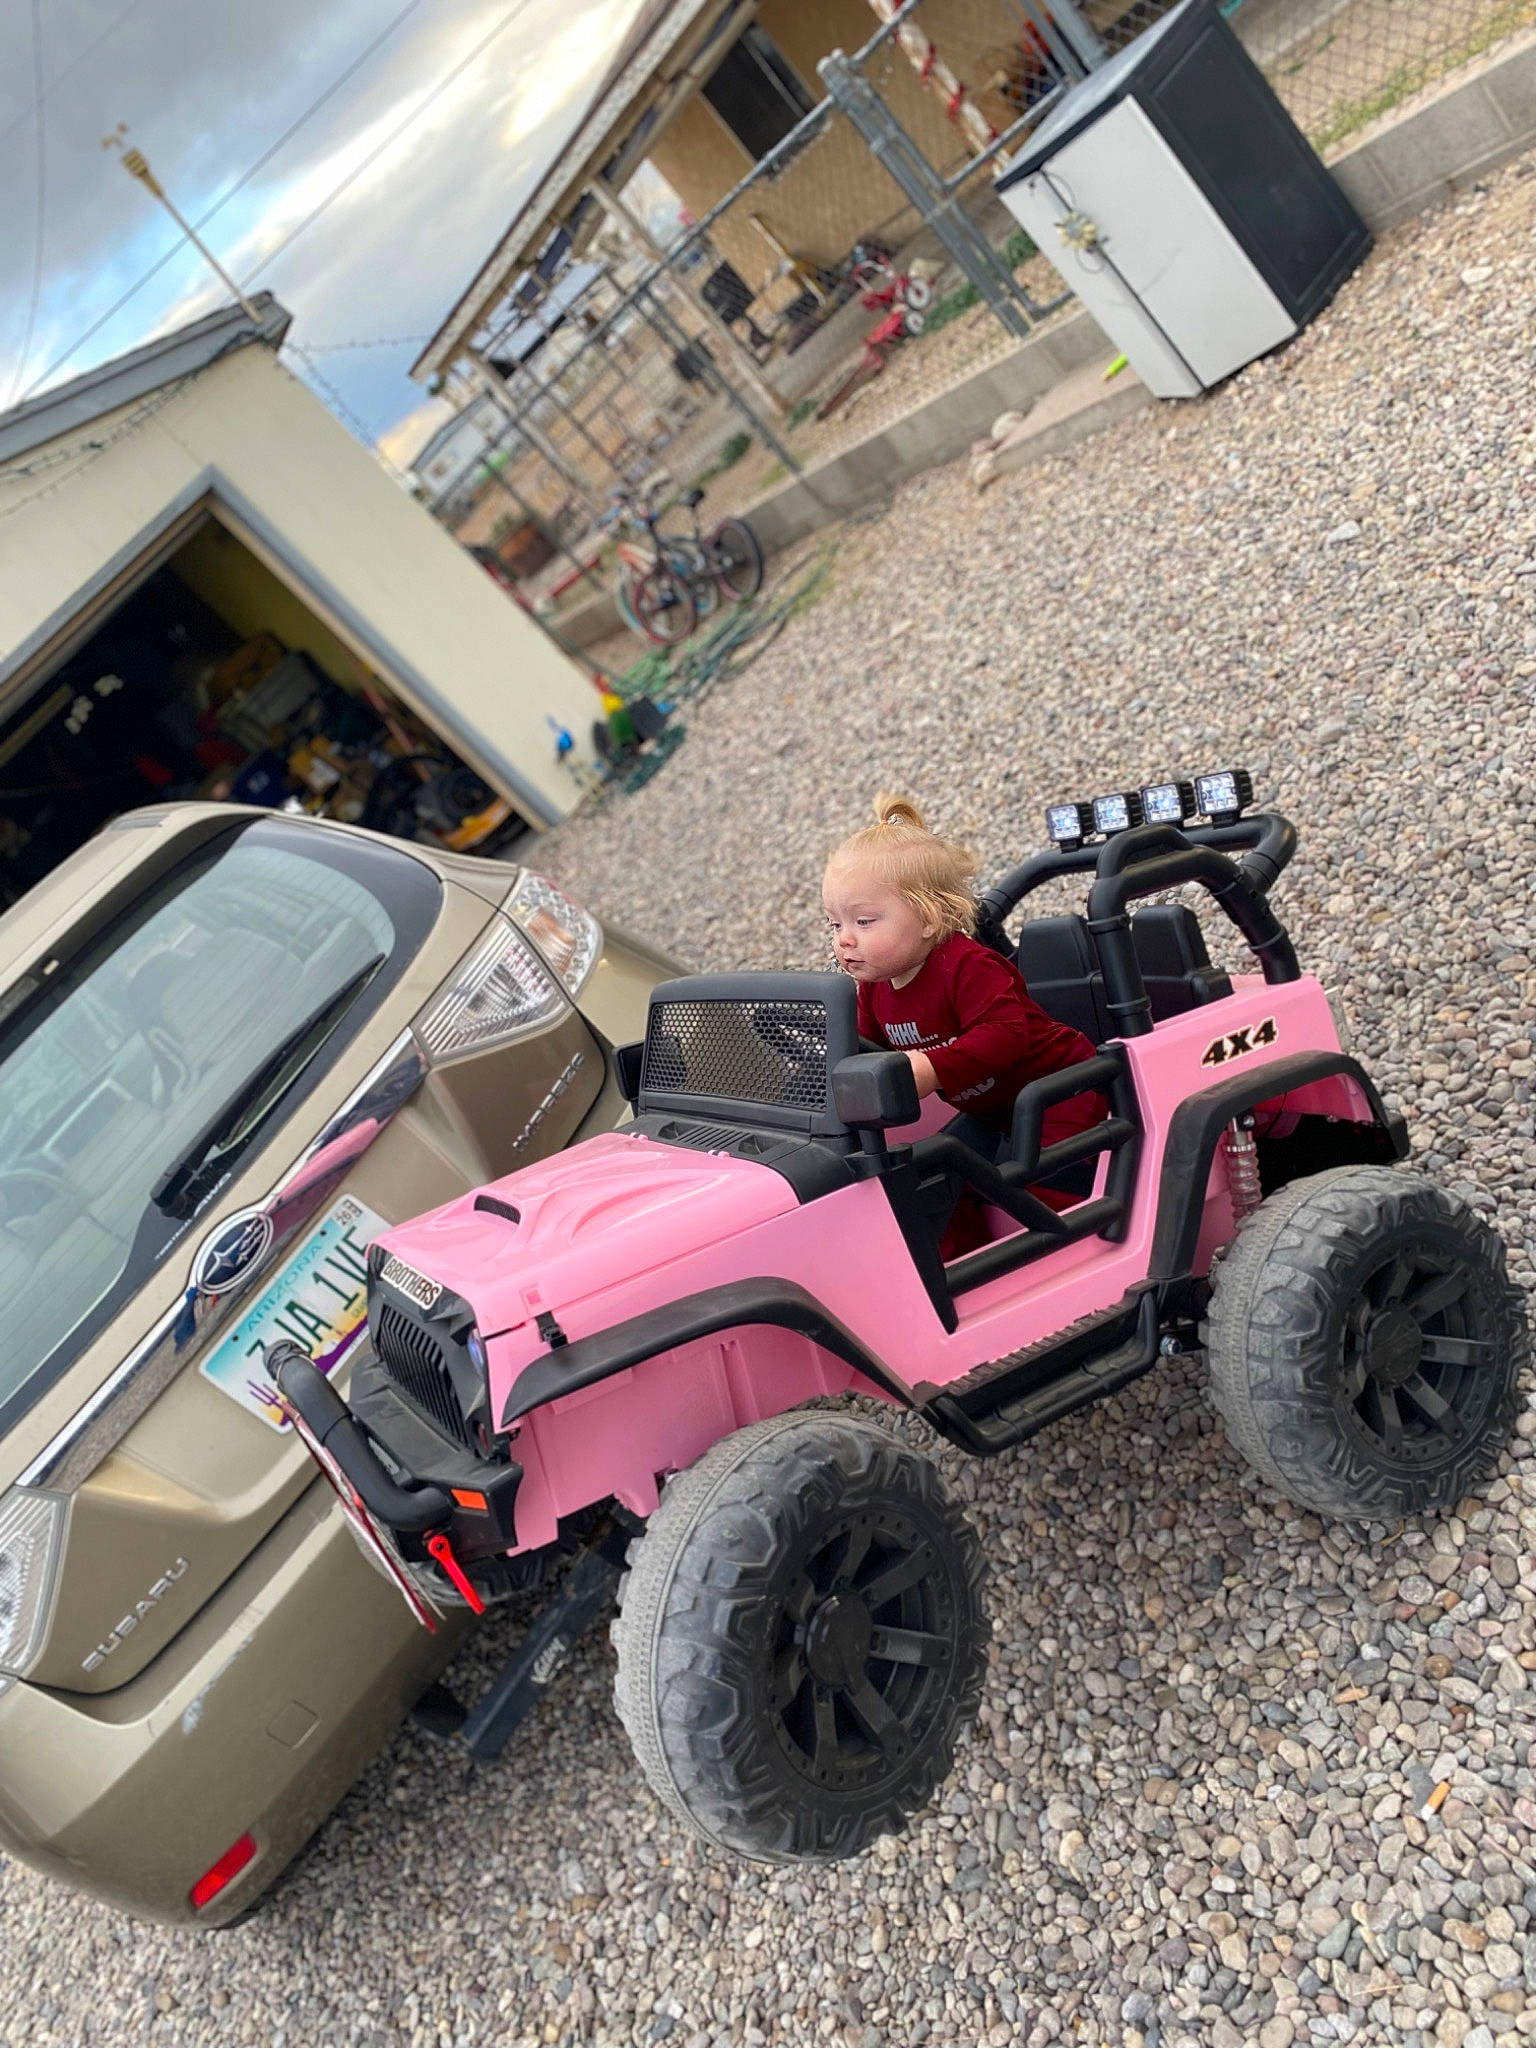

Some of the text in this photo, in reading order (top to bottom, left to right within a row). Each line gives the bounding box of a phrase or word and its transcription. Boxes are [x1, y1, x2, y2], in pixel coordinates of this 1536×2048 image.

[1201, 1018, 1277, 1066] 4X4
[246, 1244, 323, 1335] ARIZONA
[382, 1257, 440, 1307] BROTHERS
[81, 1556, 190, 1673] SUBARU
